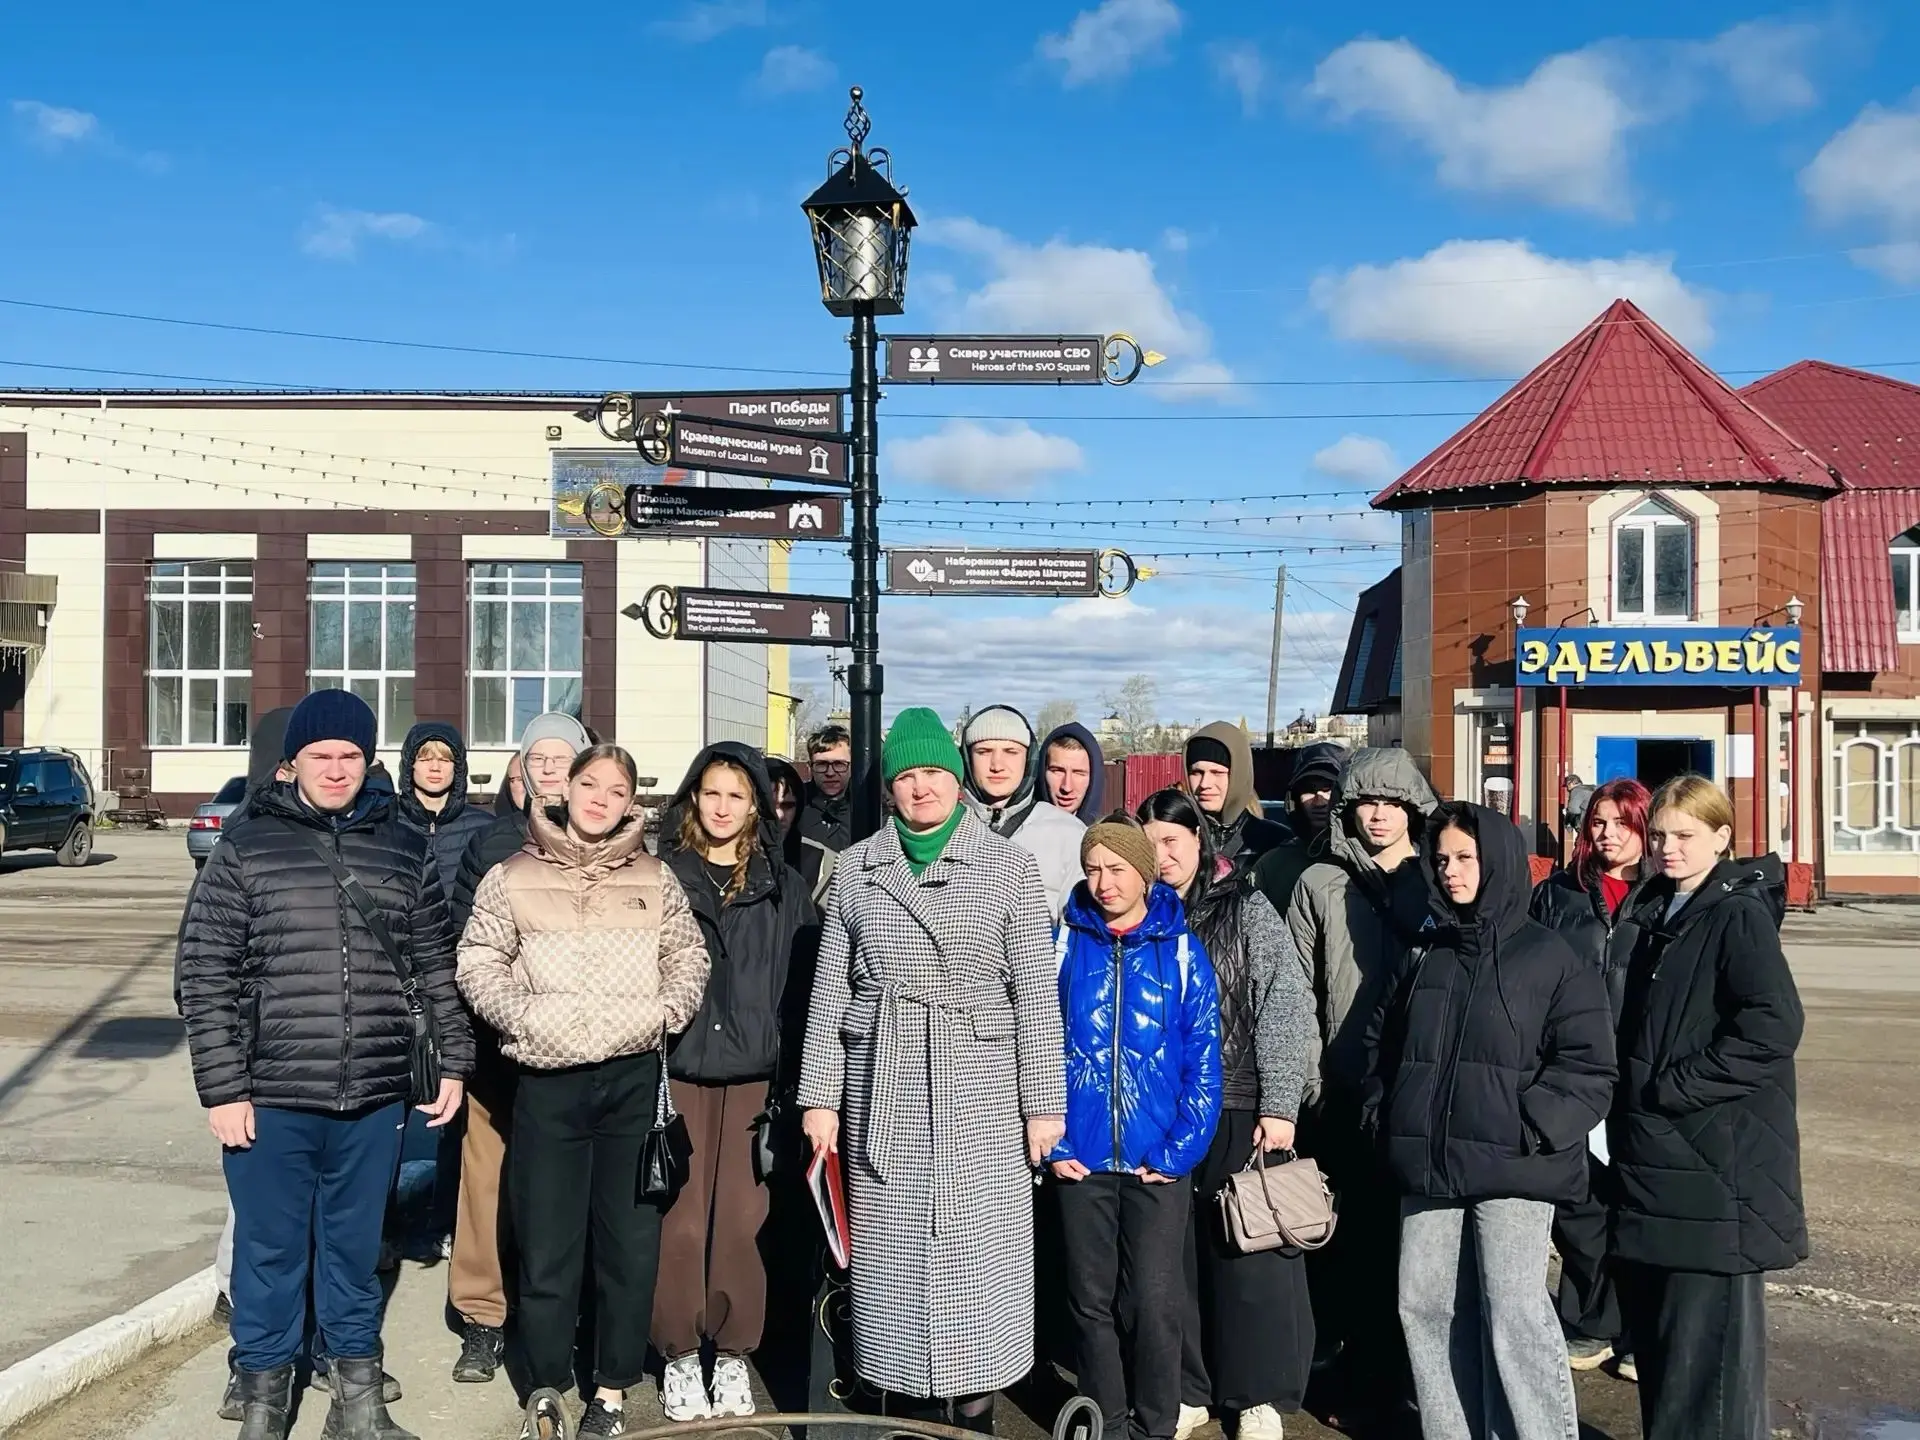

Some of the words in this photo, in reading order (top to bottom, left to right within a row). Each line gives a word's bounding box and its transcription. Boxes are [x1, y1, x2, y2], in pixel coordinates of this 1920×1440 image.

[949, 348, 988, 360] Сквер
[989, 348, 1062, 360] участников
[1063, 347, 1091, 358] СВО
[971, 362, 1005, 371] Heroes
[1006, 362, 1017, 371] of
[1017, 362, 1034, 371] the
[1035, 362, 1056, 371] SVO
[1057, 362, 1091, 373] Square
[728, 402, 767, 416] Парк
[770, 401, 831, 415] Победы
[773, 417, 806, 427] Victory
[807, 416, 830, 425] Park
[680, 429, 768, 451] Краеведческий
[769, 442, 803, 456] музей
[680, 445, 716, 458] Museum
[717, 449, 727, 459] of
[727, 450, 749, 462] Local
[750, 453, 768, 464] Lore
[636, 493, 689, 505] Площадь
[637, 506, 674, 516] имени
[676, 507, 725, 518] Максима
[726, 509, 776, 520] Захарова
[945, 557, 1010, 568] Набережная
[1011, 558, 1038, 568] реки
[1038, 558, 1087, 568] Мостовка
[965, 569, 999, 577] имени
[1001, 567, 1041, 579] Фёдора
[1042, 569, 1087, 579] Шатрова
[1519, 631, 1801, 684] ЭДЕЛЬВЕЙС
